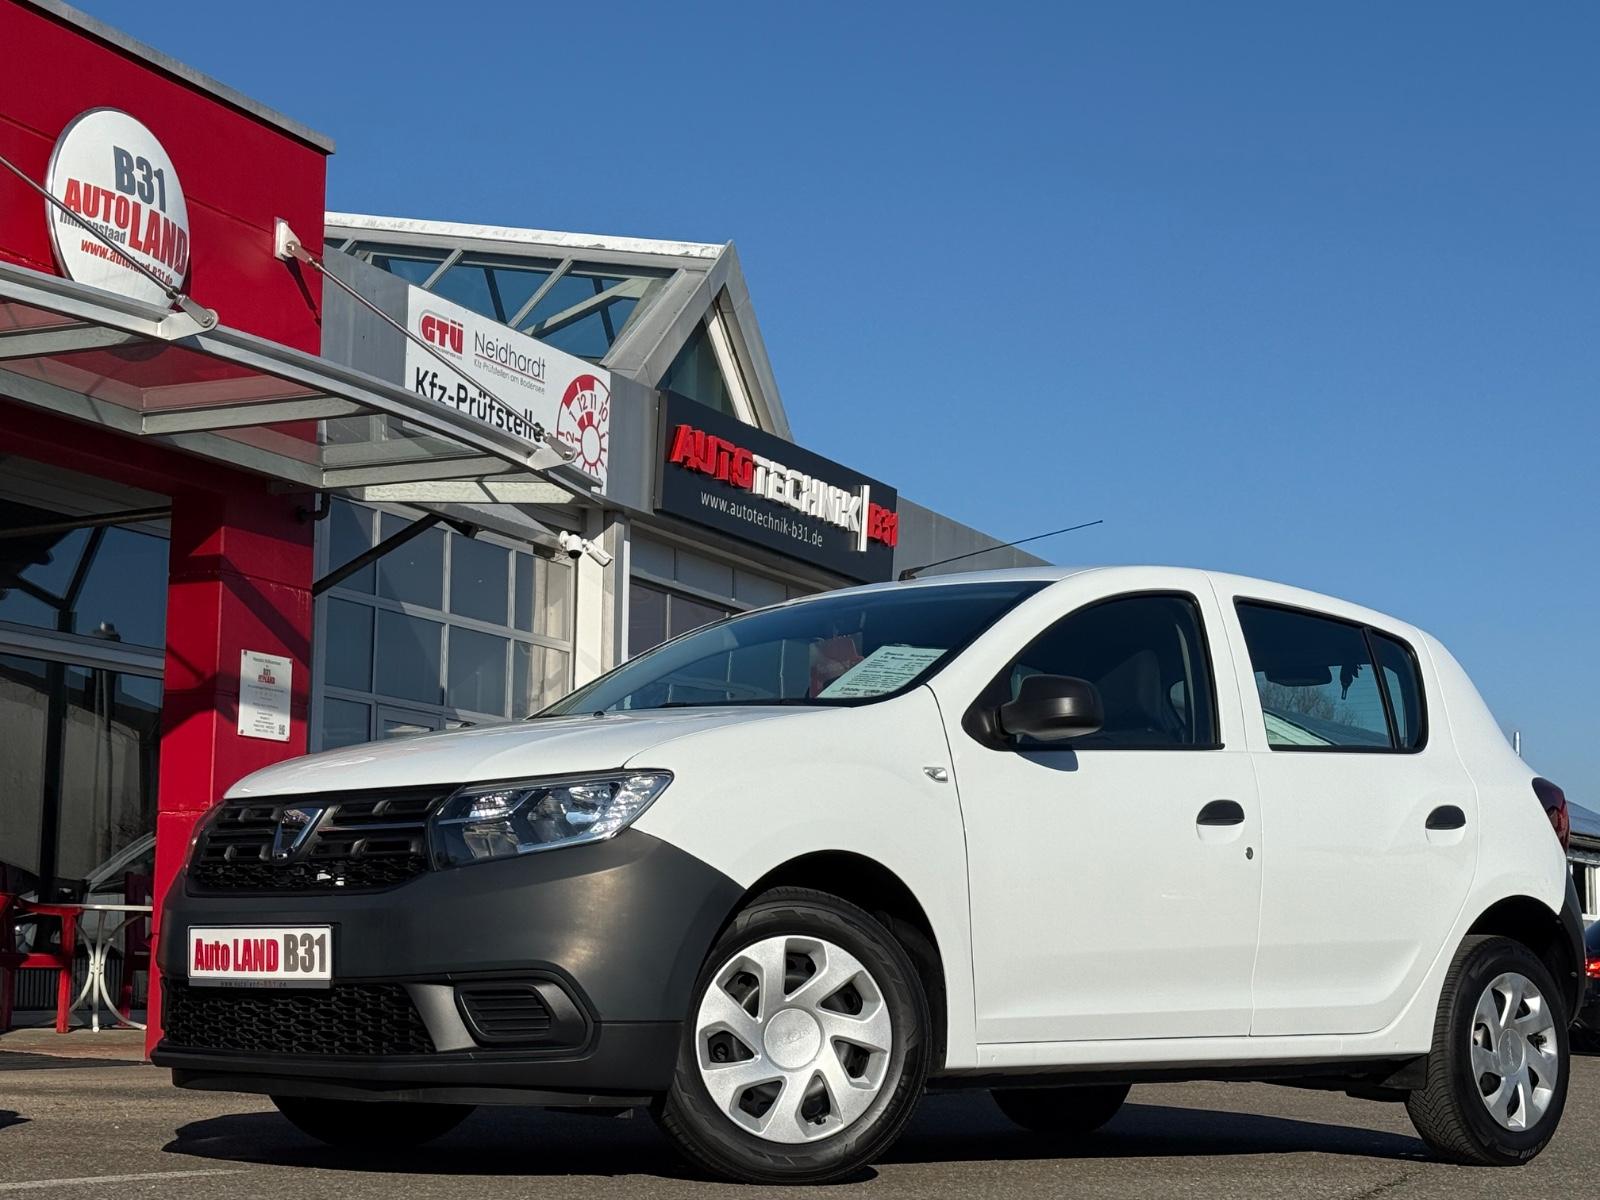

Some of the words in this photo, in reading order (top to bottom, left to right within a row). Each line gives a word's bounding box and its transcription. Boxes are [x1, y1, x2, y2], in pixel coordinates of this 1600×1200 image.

[113, 145, 166, 213] B31
[63, 178, 188, 276] AUTOLAND
[421, 315, 463, 355] GTÜ
[475, 330, 546, 380] Neidhardt
[416, 366, 543, 443] Kfz-Prüfstelle
[700, 490, 823, 547] www.autotechnik-b31.de
[194, 938, 230, 972] Auto
[233, 938, 279, 972] LAND
[283, 933, 327, 973] B31
